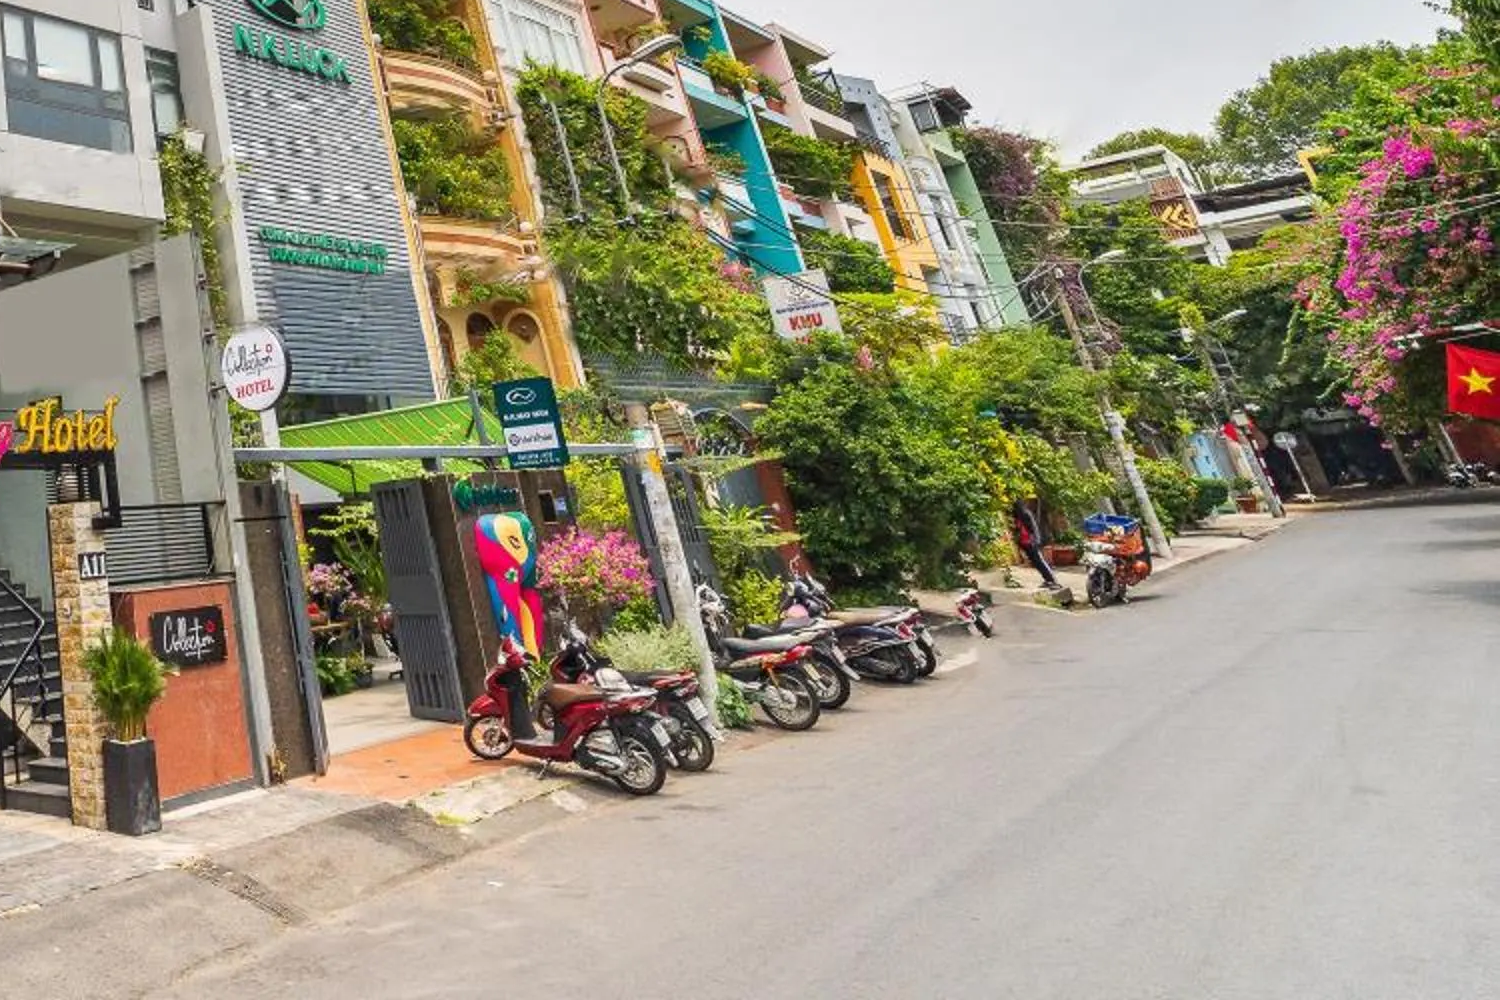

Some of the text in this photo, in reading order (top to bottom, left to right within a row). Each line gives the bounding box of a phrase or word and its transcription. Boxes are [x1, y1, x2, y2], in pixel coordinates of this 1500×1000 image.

[235, 378, 275, 398] HOTEL
[14, 394, 122, 455] Hotel
[81, 554, 106, 578] A11
